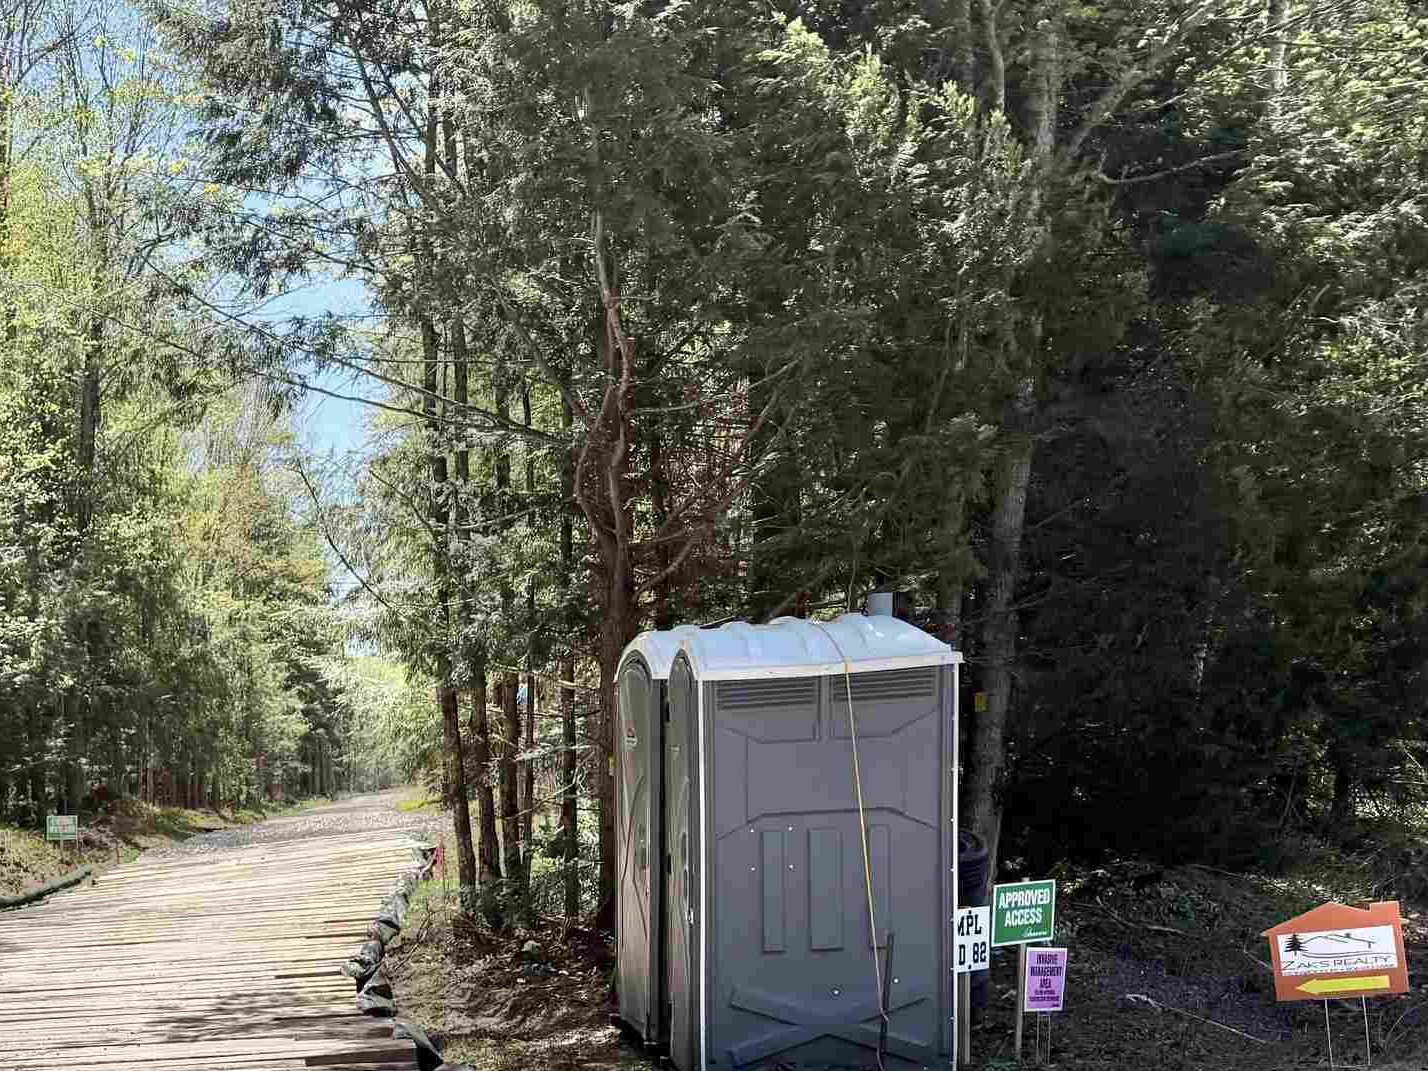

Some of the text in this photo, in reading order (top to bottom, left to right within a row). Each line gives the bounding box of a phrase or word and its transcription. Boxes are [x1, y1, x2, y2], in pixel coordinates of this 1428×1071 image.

[998, 888, 1051, 909] APPROVED
[1004, 908, 1043, 927] ACCESS
[973, 941, 987, 963] 82
